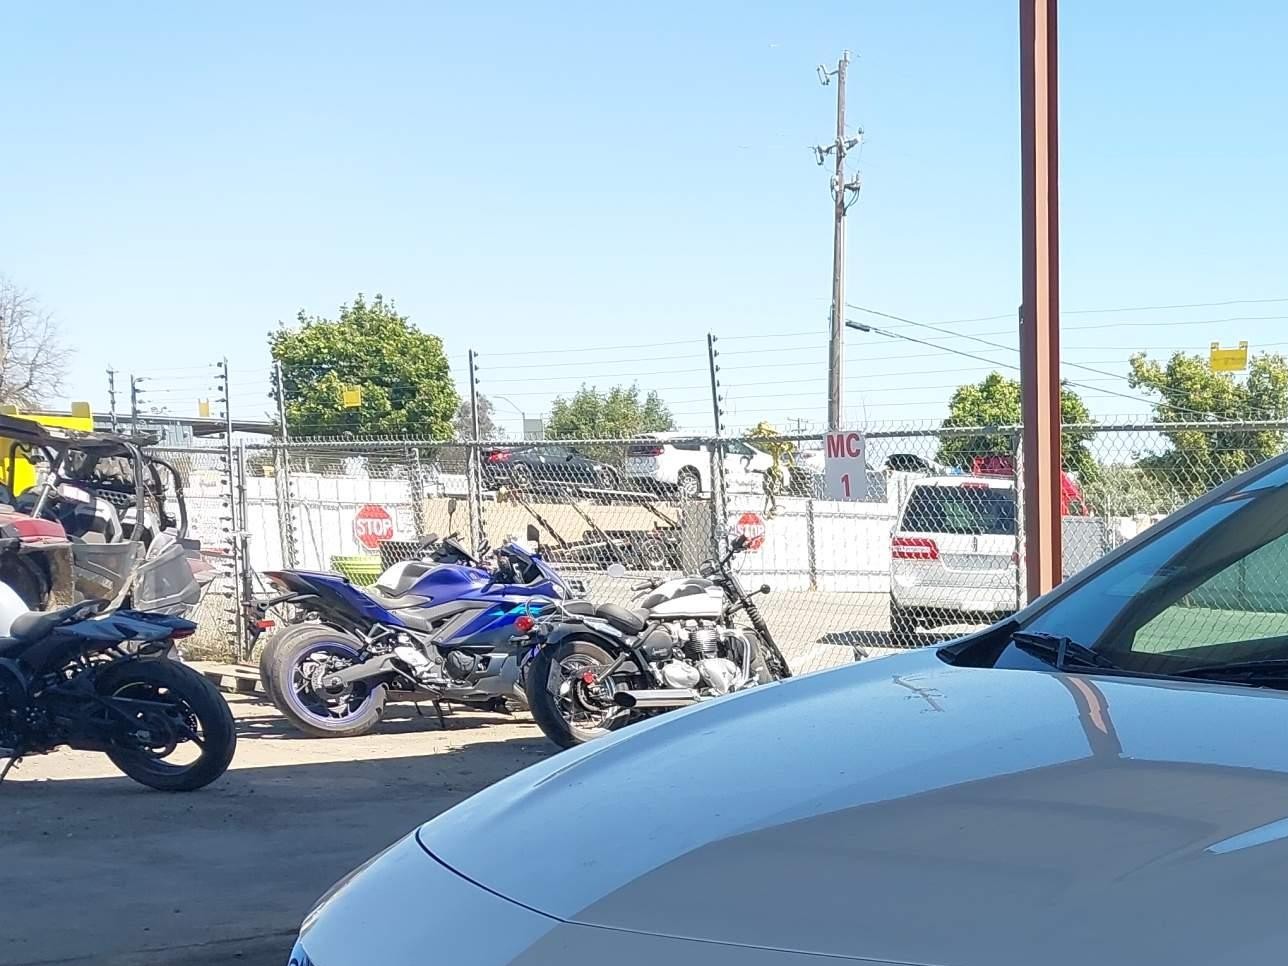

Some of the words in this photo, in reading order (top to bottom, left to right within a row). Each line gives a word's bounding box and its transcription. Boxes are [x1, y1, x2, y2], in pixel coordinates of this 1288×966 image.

[827, 433, 861, 458] MC
[841, 474, 851, 497] 1
[357, 519, 392, 538] STOP
